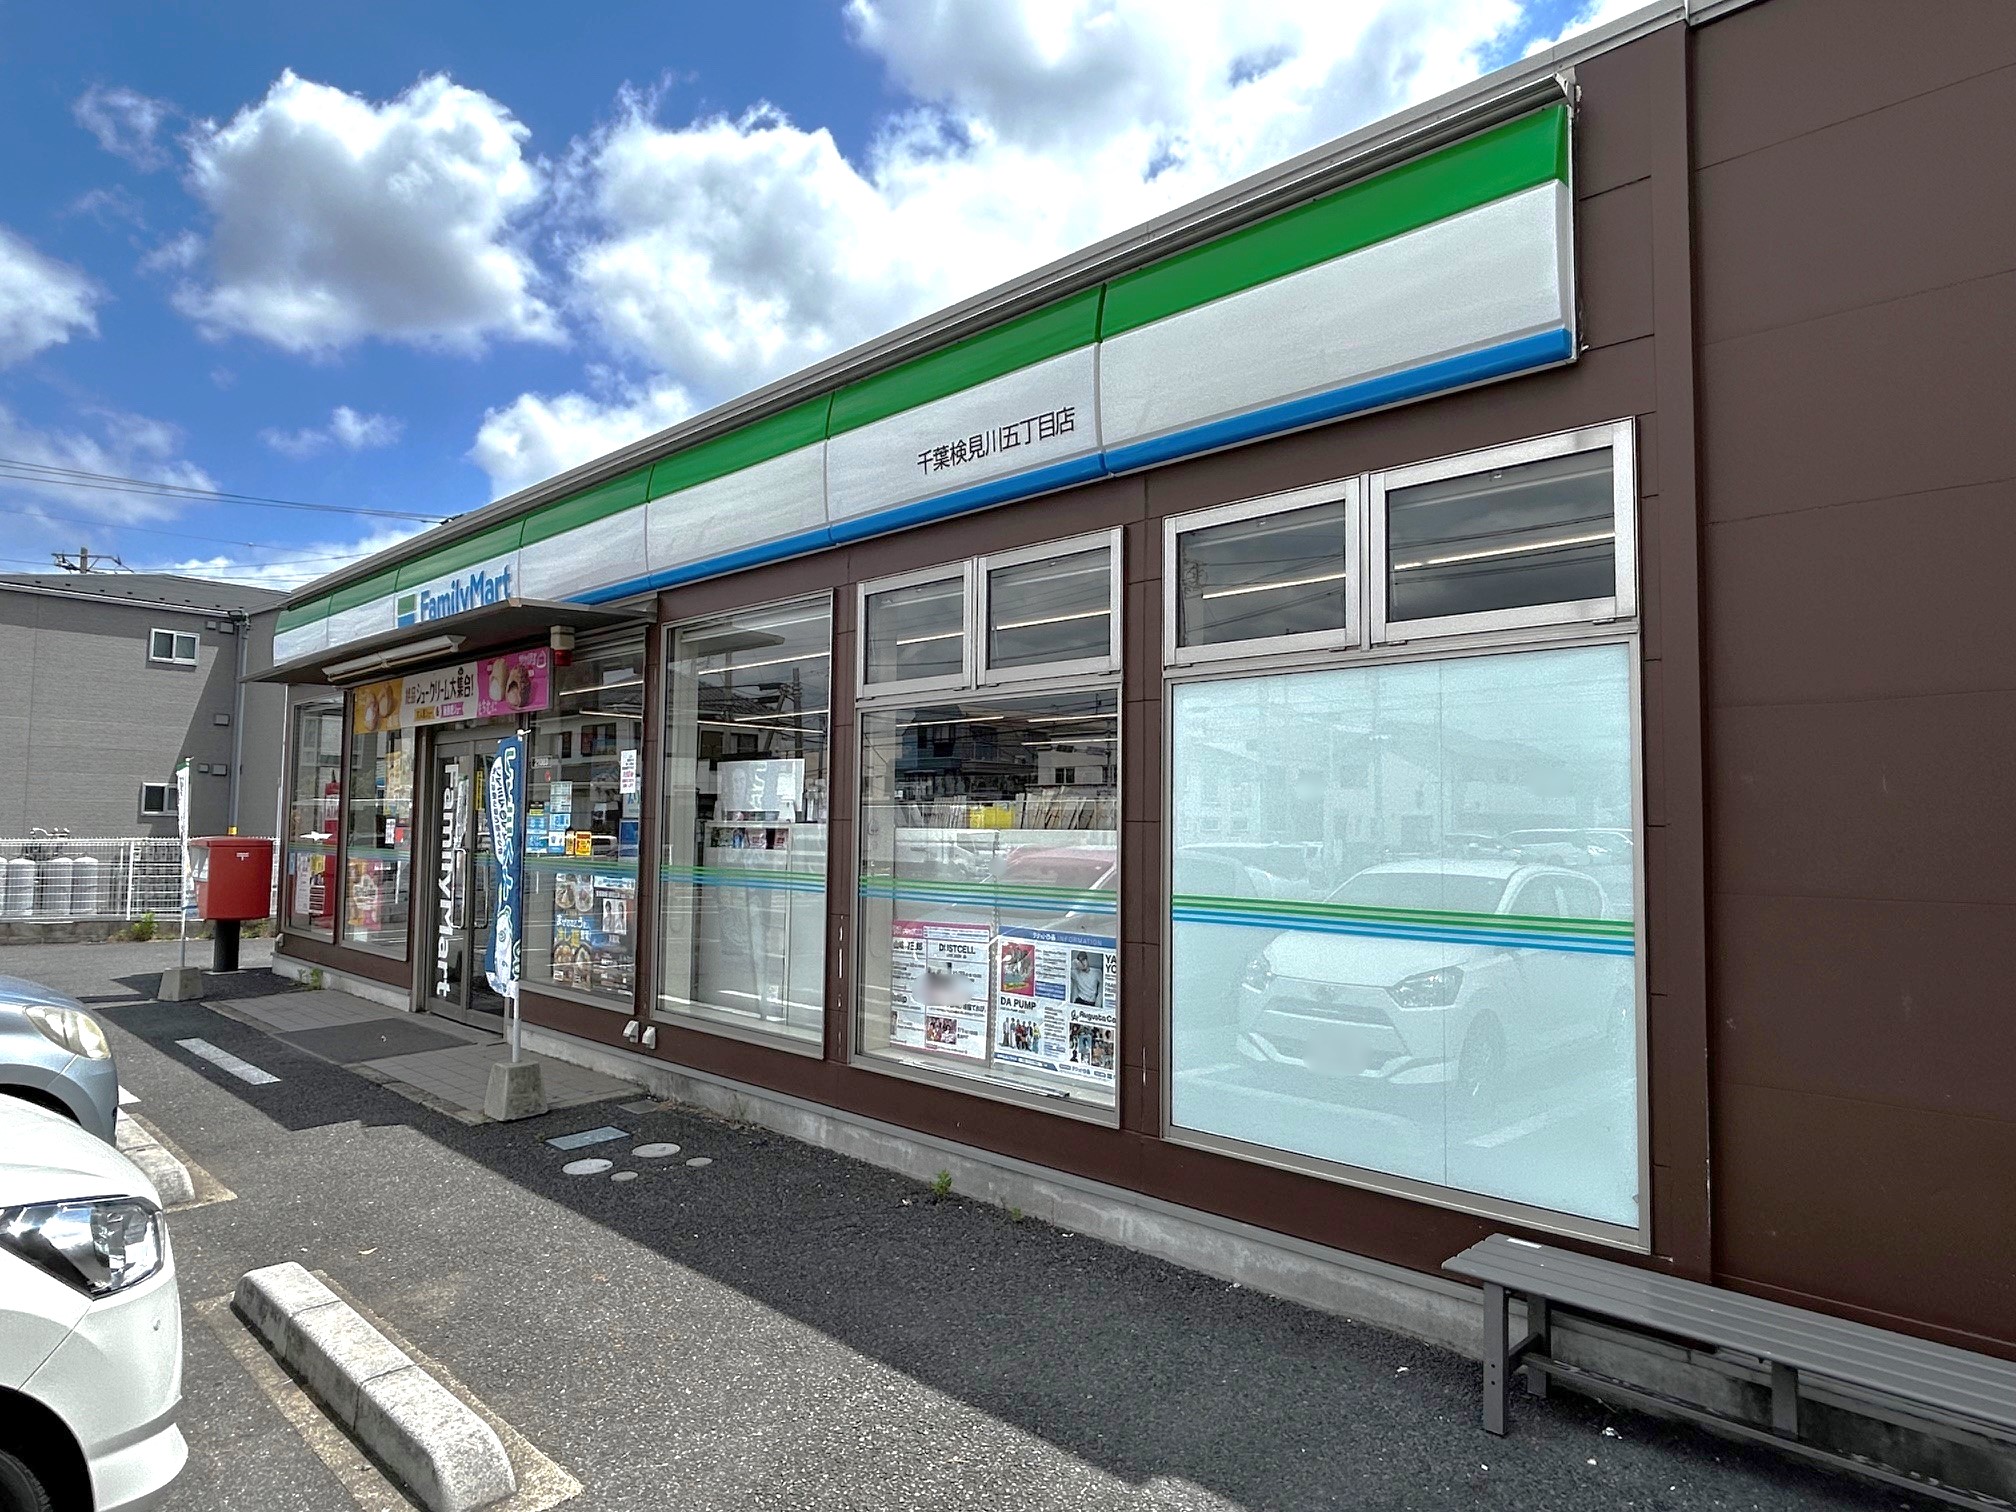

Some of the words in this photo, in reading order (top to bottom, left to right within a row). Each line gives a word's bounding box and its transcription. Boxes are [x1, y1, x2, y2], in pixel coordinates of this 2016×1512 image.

[917, 406, 1075, 475] 千葉検見川五丁目店
[421, 564, 512, 622] FamilyMart
[436, 763, 459, 998] FamilyMart
[1056, 934, 1103, 946] INFORMATION
[1000, 996, 1012, 1007] DA
[1013, 998, 1037, 1011] PUMP
